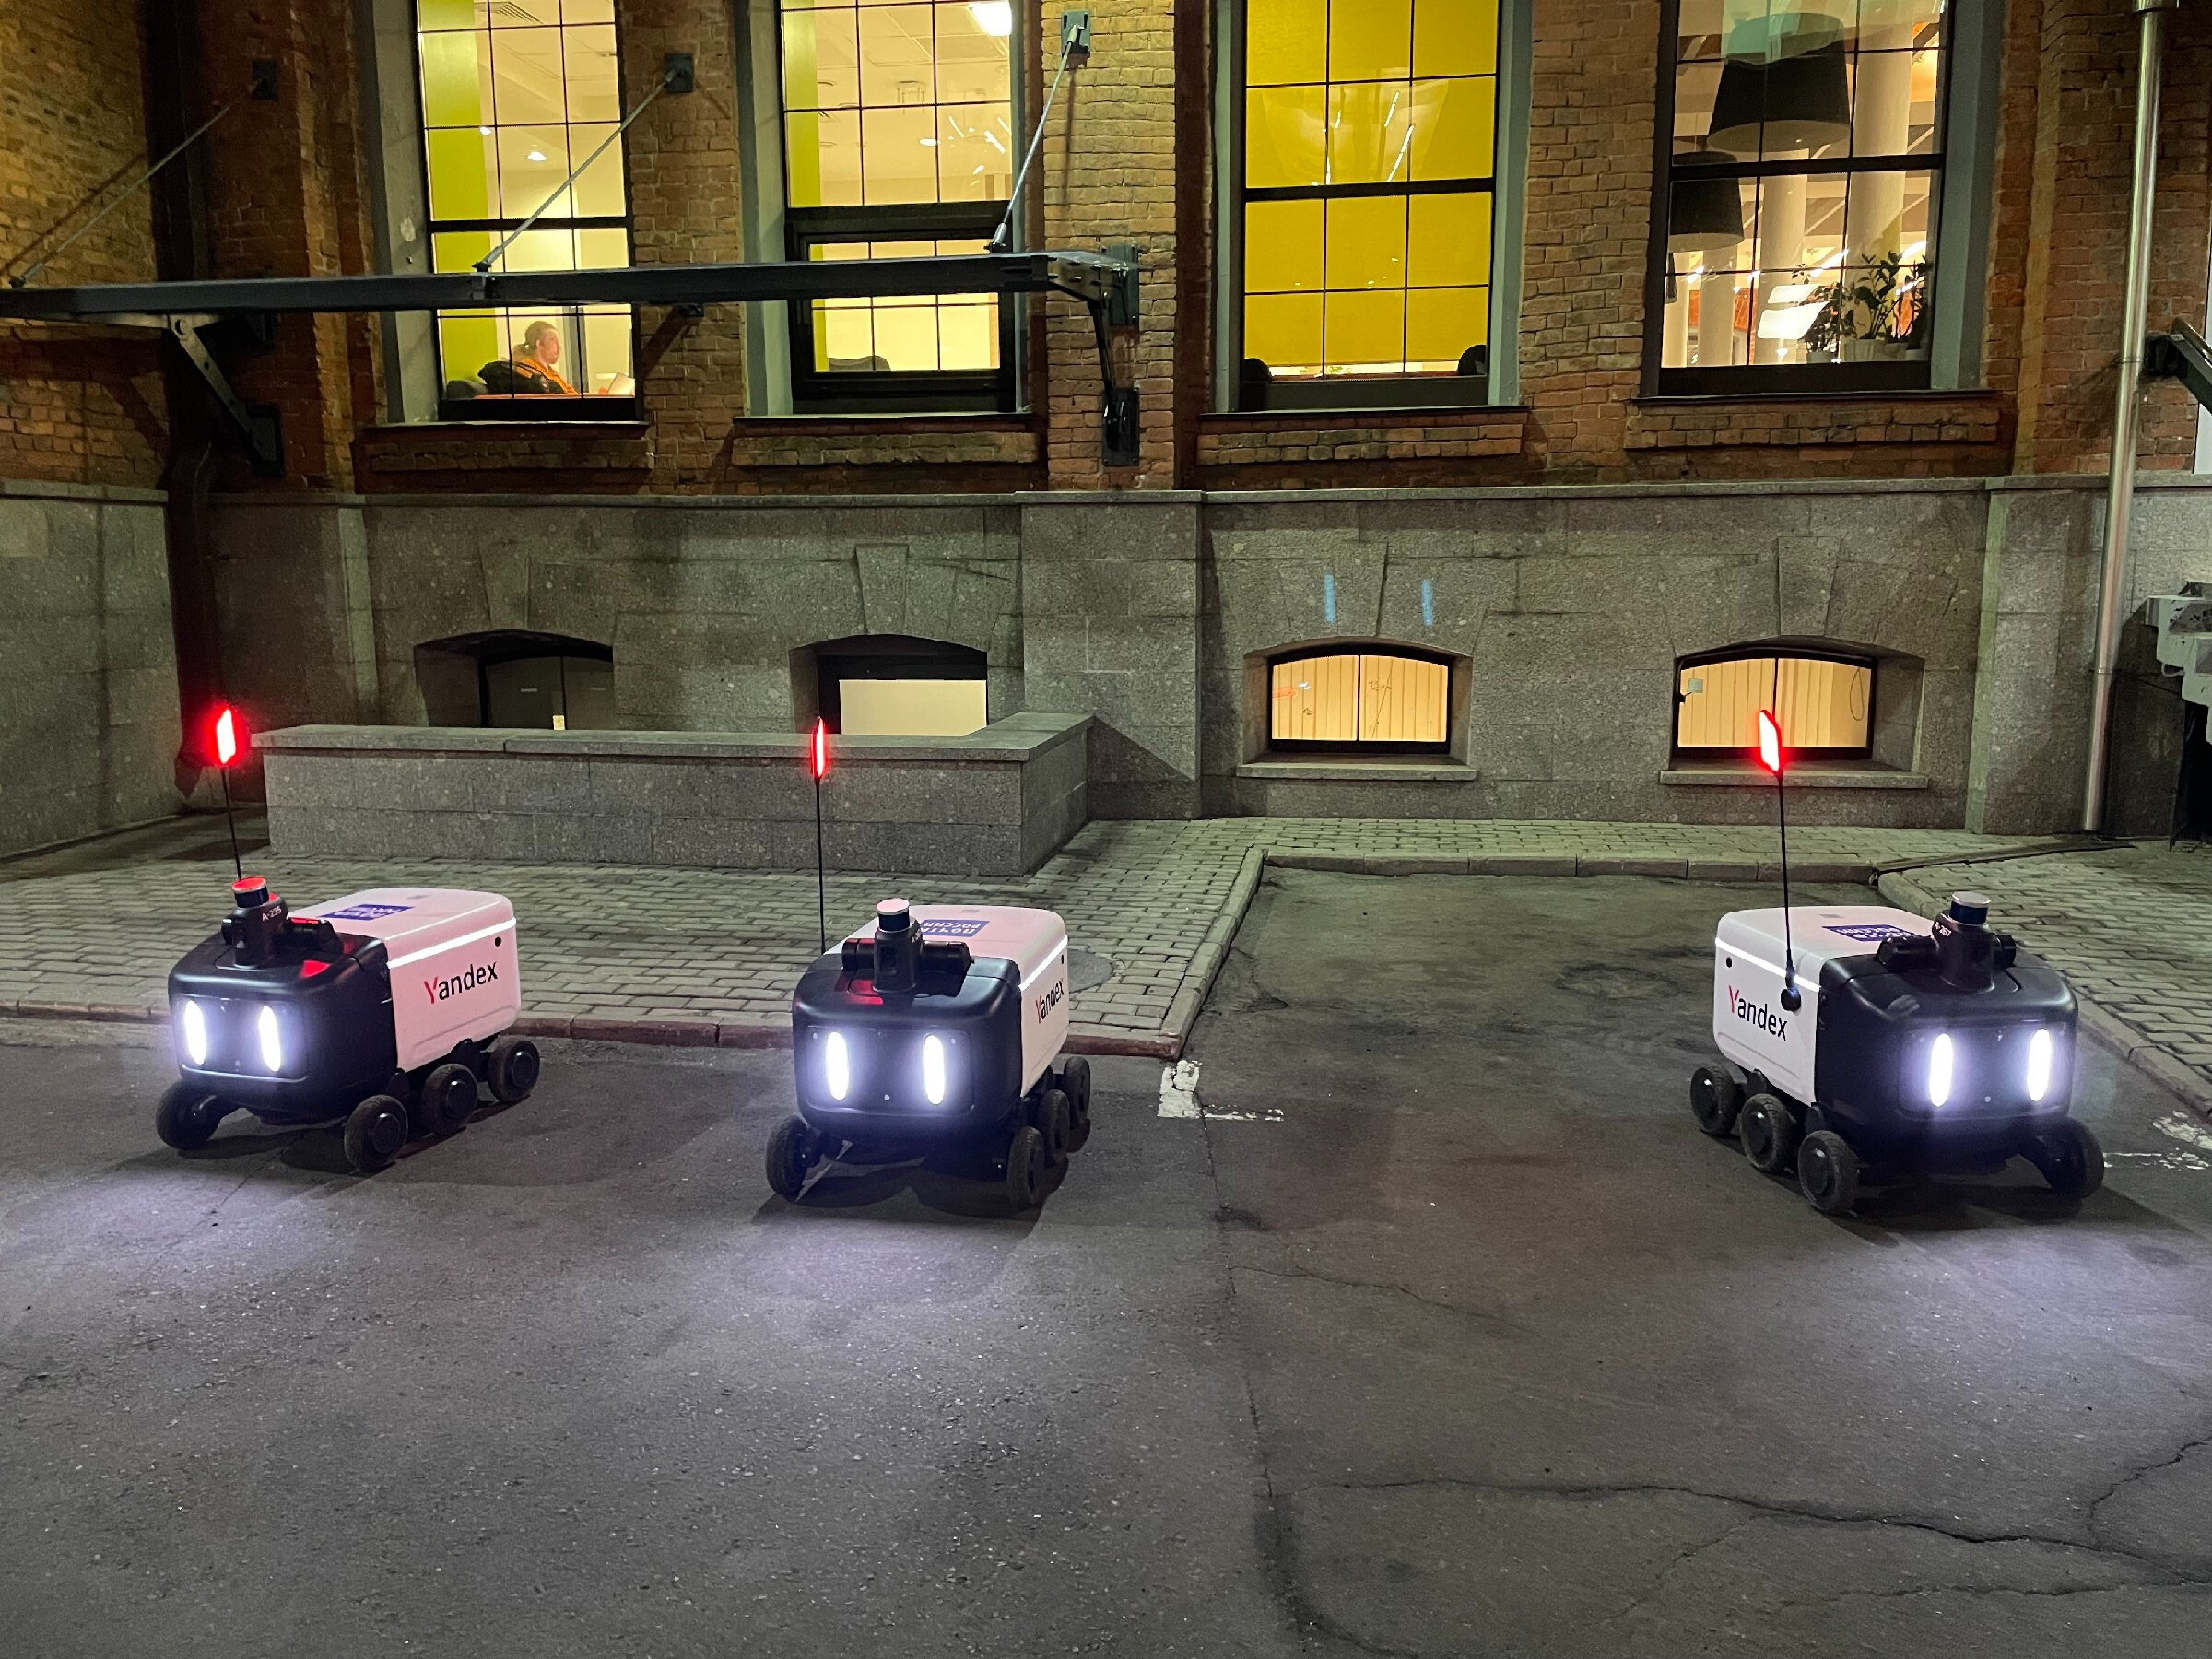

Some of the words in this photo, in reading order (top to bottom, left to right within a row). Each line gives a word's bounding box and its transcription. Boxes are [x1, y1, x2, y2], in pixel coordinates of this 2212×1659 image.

[424, 962, 498, 1004] Yandex
[1035, 977, 1065, 1024] Yandex
[1728, 985, 1788, 1041] Yandex
